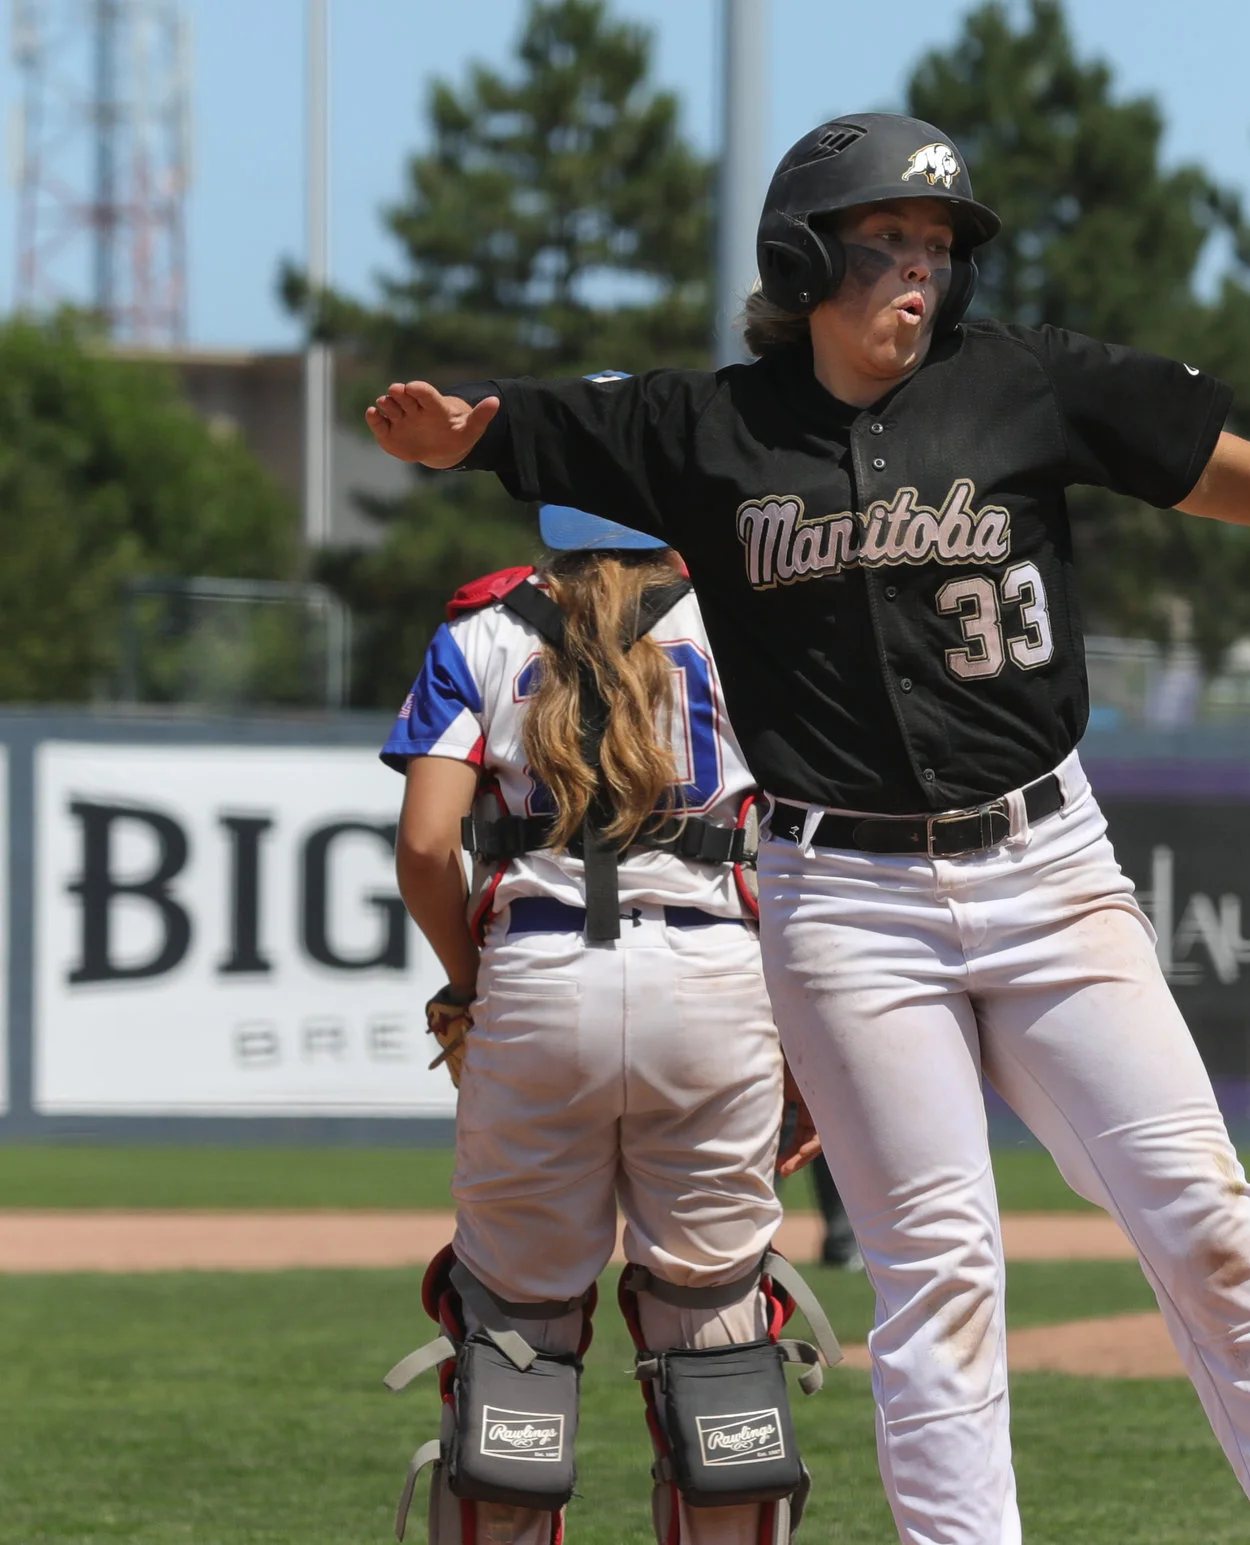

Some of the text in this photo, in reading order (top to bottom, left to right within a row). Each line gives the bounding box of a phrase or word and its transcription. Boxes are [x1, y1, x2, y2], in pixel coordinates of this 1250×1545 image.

[736, 477, 1011, 591] Manitoba
[935, 560, 1055, 681] 33
[67, 796, 413, 985] BIG
[488, 1424, 558, 1446] Rawlings
[707, 1424, 776, 1450] Rawlings
